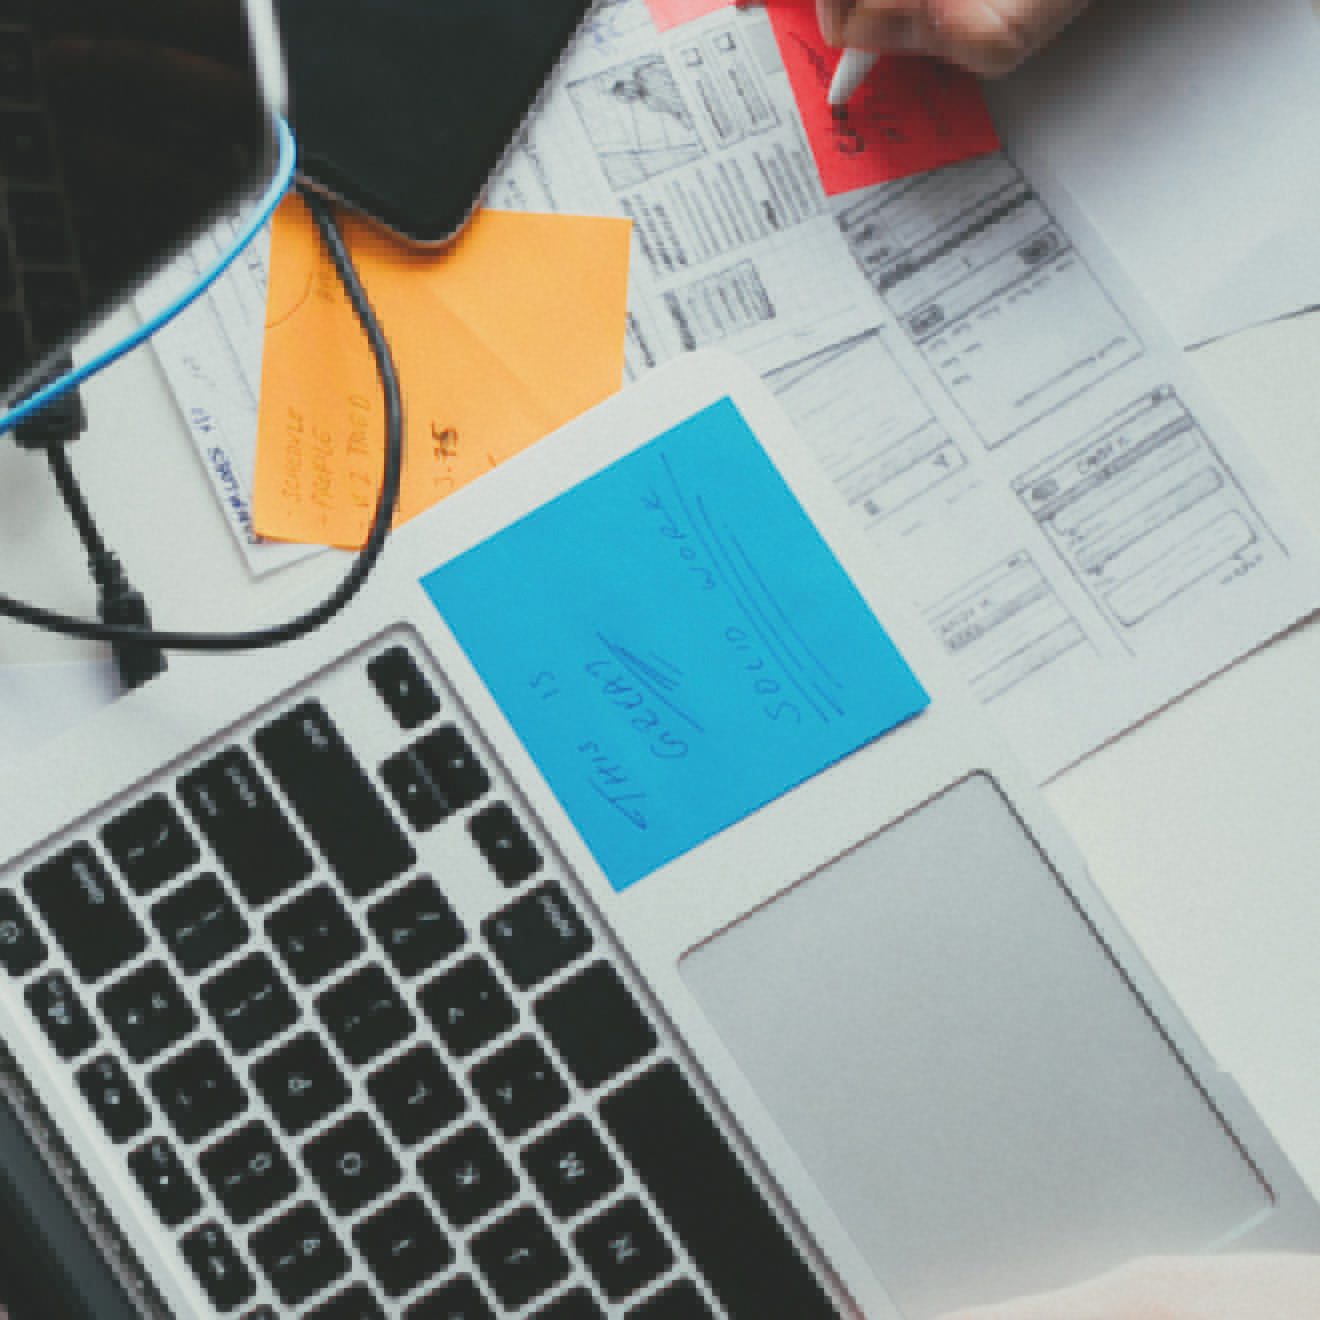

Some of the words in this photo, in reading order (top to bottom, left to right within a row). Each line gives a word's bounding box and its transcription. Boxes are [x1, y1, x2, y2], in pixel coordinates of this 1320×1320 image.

[529, 670, 559, 700] IS
[724, 625, 801, 725] SOLID
[578, 740, 648, 831] THIS
